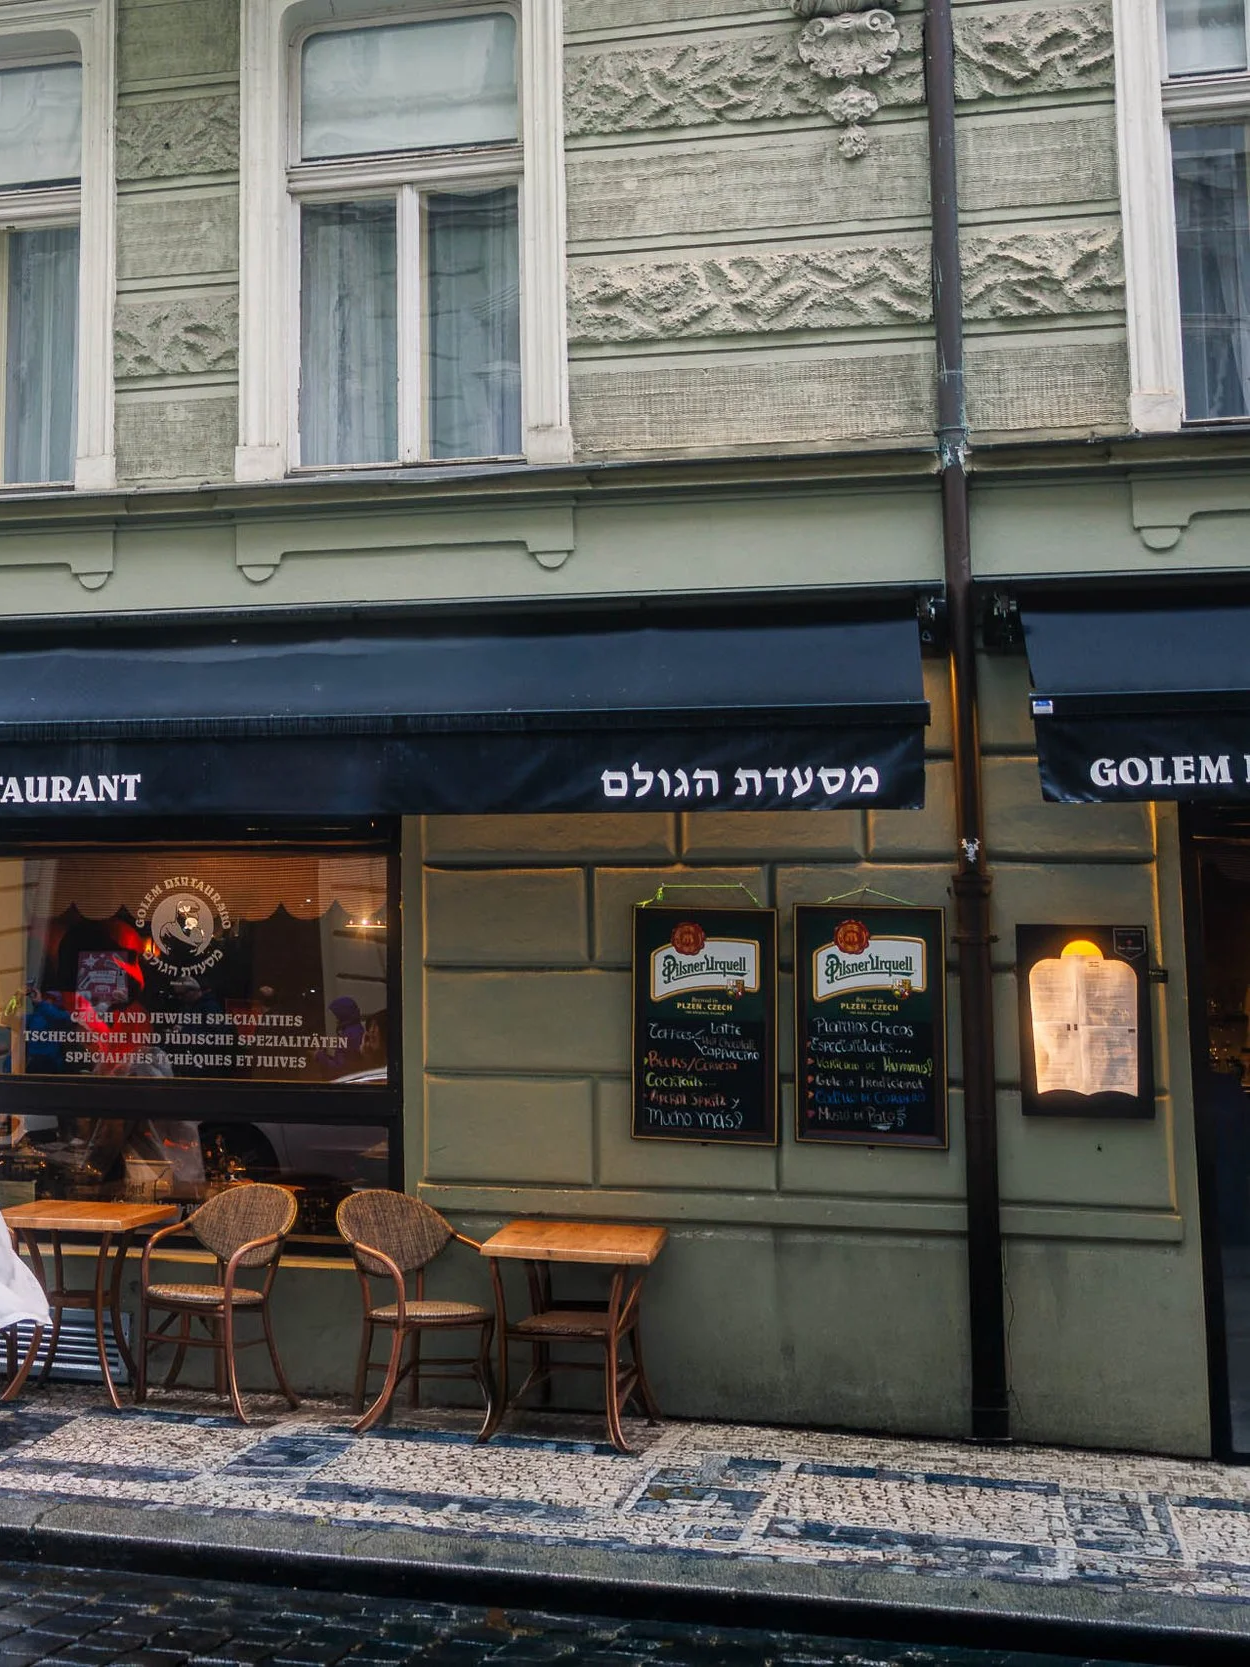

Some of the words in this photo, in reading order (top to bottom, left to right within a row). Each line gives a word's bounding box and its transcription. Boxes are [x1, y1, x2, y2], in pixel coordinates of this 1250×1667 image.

[601, 762, 719, 798] הגולם
[734, 765, 879, 798] מסעדת
[1090, 755, 1233, 787] GOLEM
[135, 884, 163, 928] GOLEM
[662, 954, 705, 984] Pilsner
[705, 954, 746, 977] Urquell
[825, 953, 870, 984] Pilsner
[869, 953, 913, 977] Urquell
[70, 1011, 114, 1023] CZECH
[118, 1012, 146, 1023] AND
[150, 1012, 202, 1025] JEWISH
[206, 1013, 303, 1027] SPECIALITIES
[23, 1030, 128, 1044] TSCHECHISCHE
[131, 1032, 162, 1044] UND
[164, 1029, 234, 1046] JÜDISCHE
[238, 1033, 348, 1048] SPEZIALITÄTEN
[157, 1050, 232, 1068] TCHÈQUES
[236, 1055, 253, 1067] ET
[256, 1056, 307, 1068] JUIVES
